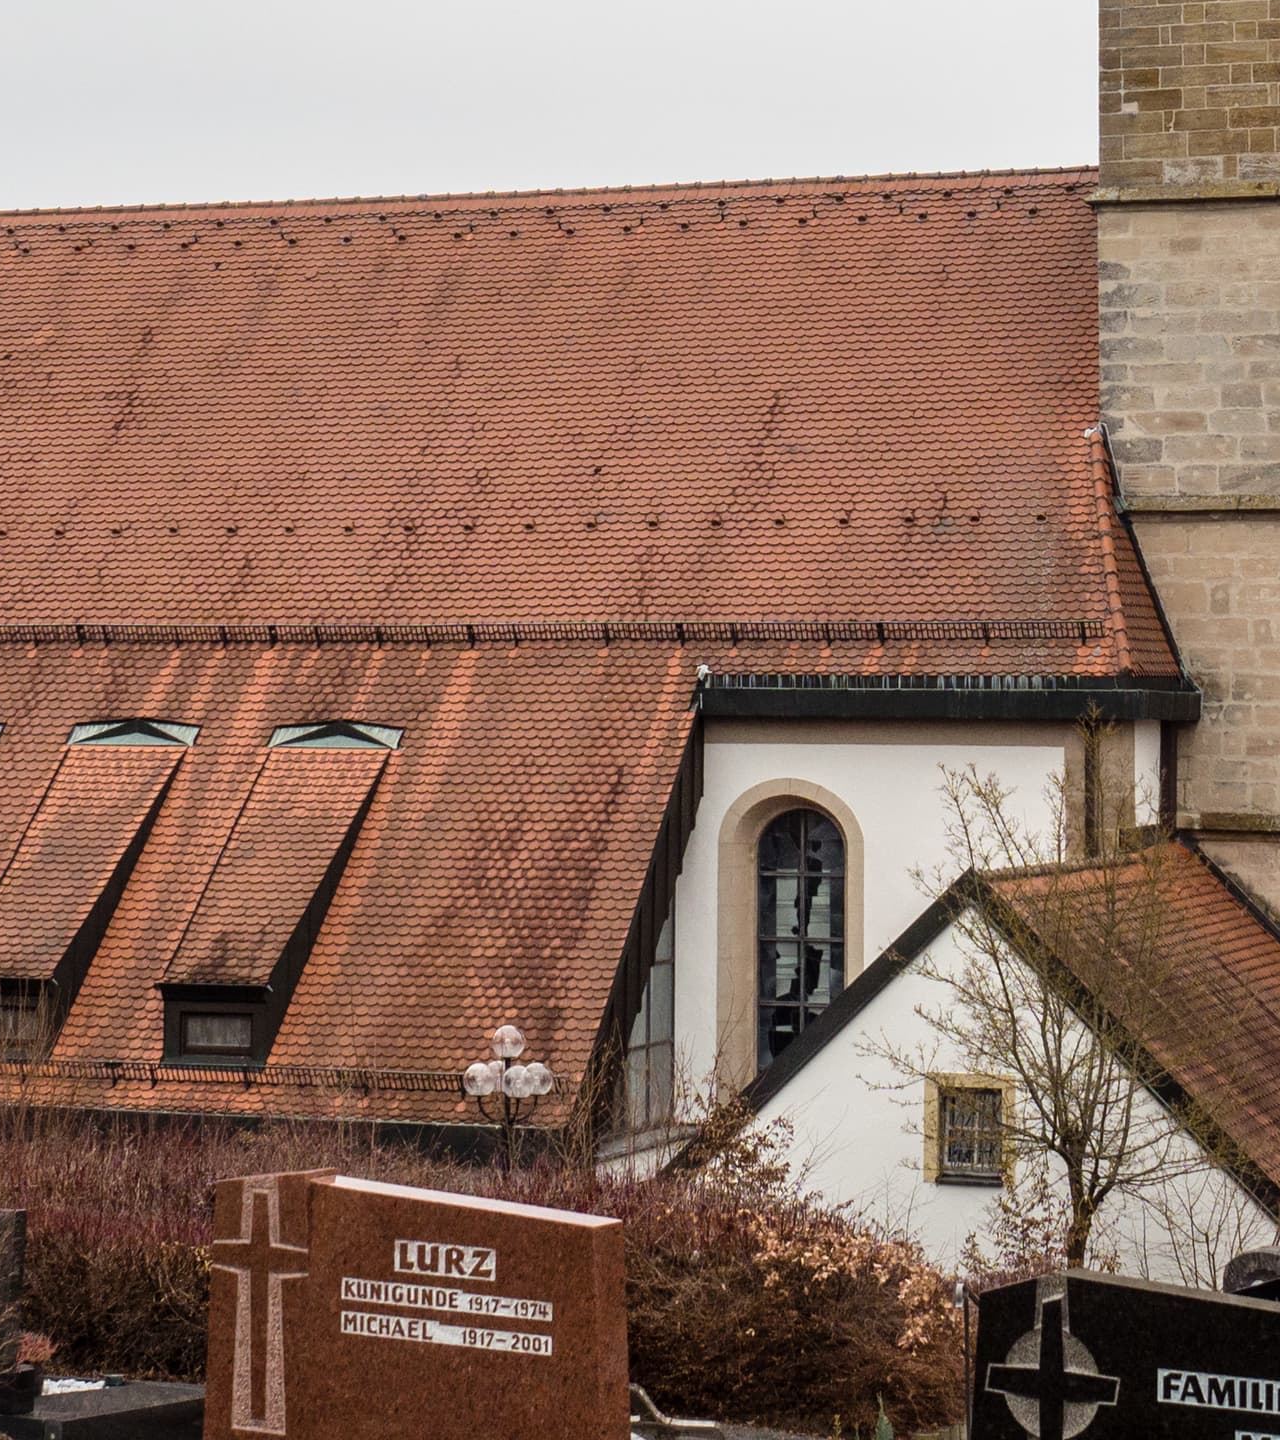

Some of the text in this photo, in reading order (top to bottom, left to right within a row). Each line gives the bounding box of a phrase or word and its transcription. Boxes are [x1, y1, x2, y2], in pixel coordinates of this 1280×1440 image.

[398, 1242, 494, 1278] LURZ
[343, 1279, 459, 1309] KUNIGUNDE
[343, 1313, 434, 1341] MICHAEL
